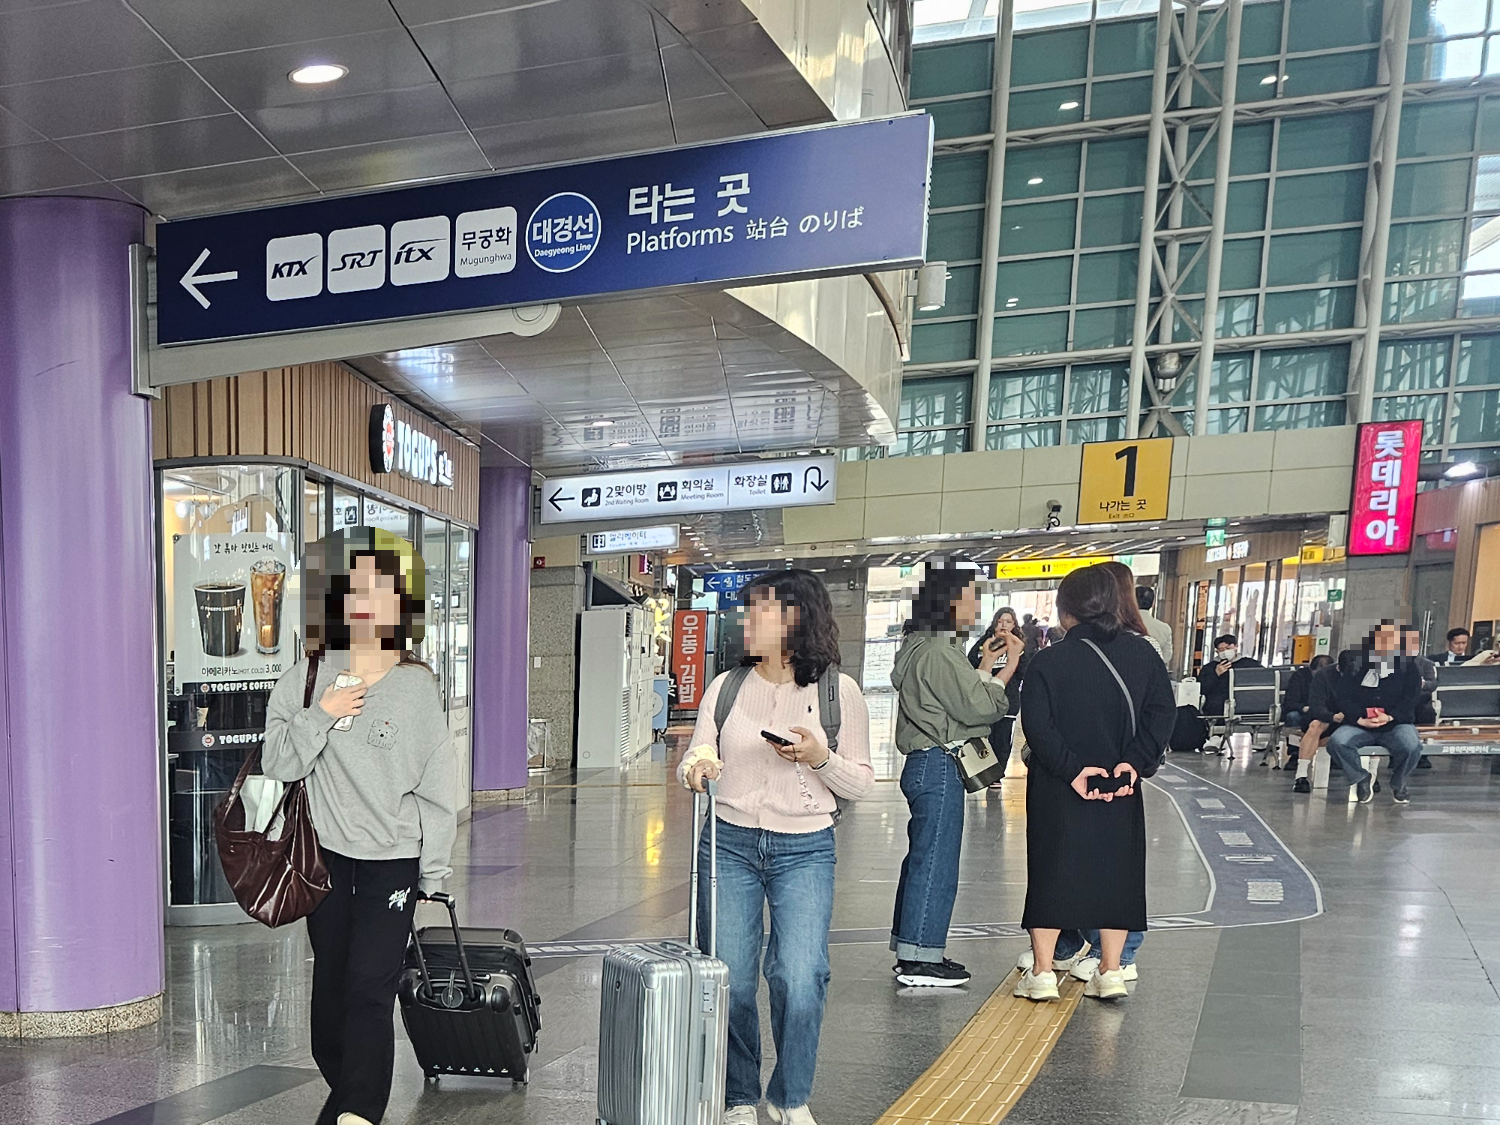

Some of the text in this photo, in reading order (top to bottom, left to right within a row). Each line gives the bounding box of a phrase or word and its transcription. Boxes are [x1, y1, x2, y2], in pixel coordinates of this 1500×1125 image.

[628, 172, 750, 224] 타는 곳
[532, 213, 594, 244] 대경선
[627, 205, 864, 254] Platforms 站台 のりば
[461, 226, 512, 250] 무궁화
[534, 243, 592, 257] Daegyeong Line
[271, 255, 319, 279] KTX
[331, 249, 383, 272] SRT
[460, 253, 512, 266] Mugunghwa
[1115, 446, 1138, 497] 1
[681, 478, 714, 491] 회의실
[734, 475, 767, 487] 화장실
[1366, 430, 1405, 546] 롯데리아
[605, 483, 647, 498] 2맞이방
[681, 492, 705, 500] Meeting
[1100, 499, 1147, 512] 나가는 곳
[211, 682, 247, 691] TOGUPS
[219, 734, 257, 744] TOGUPS
